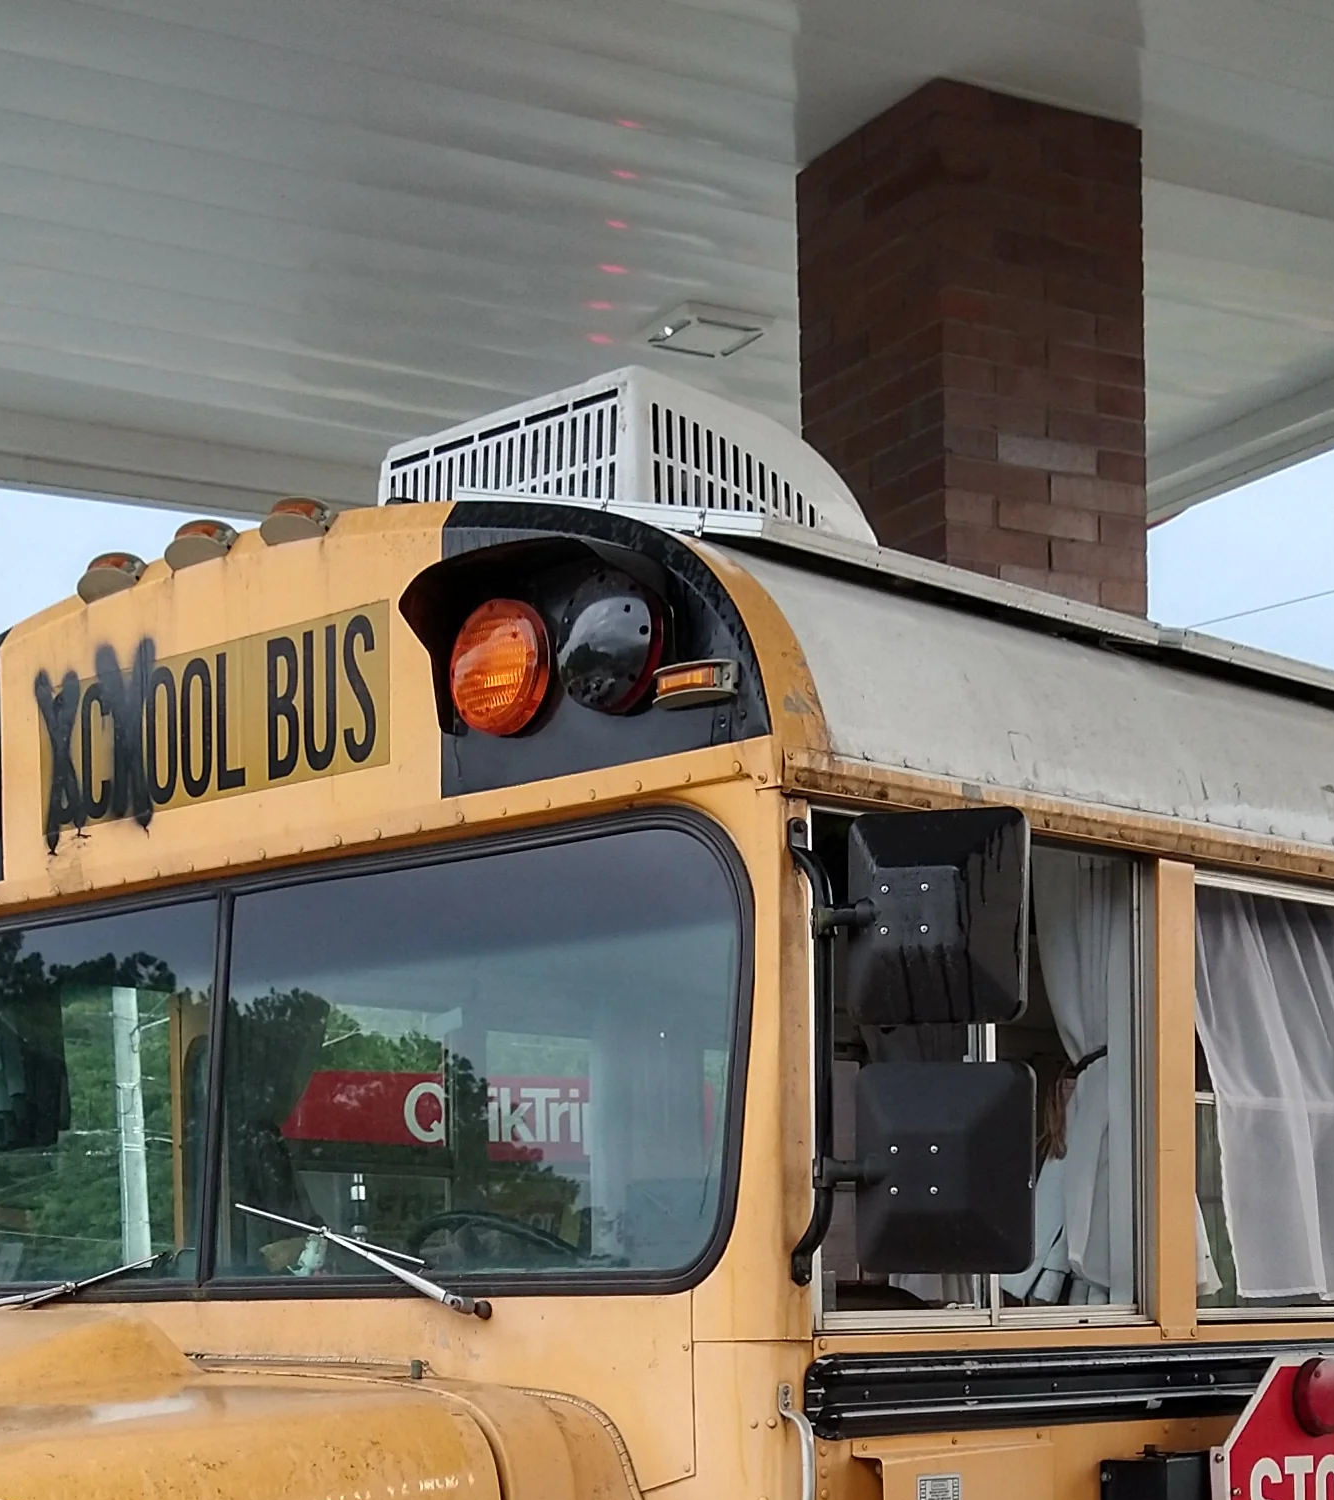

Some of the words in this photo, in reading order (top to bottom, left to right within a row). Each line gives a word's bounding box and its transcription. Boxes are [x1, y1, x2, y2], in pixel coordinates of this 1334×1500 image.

[41, 645, 246, 830] COOL
[267, 613, 378, 781] BUS
[403, 1081, 591, 1156] QikTri
